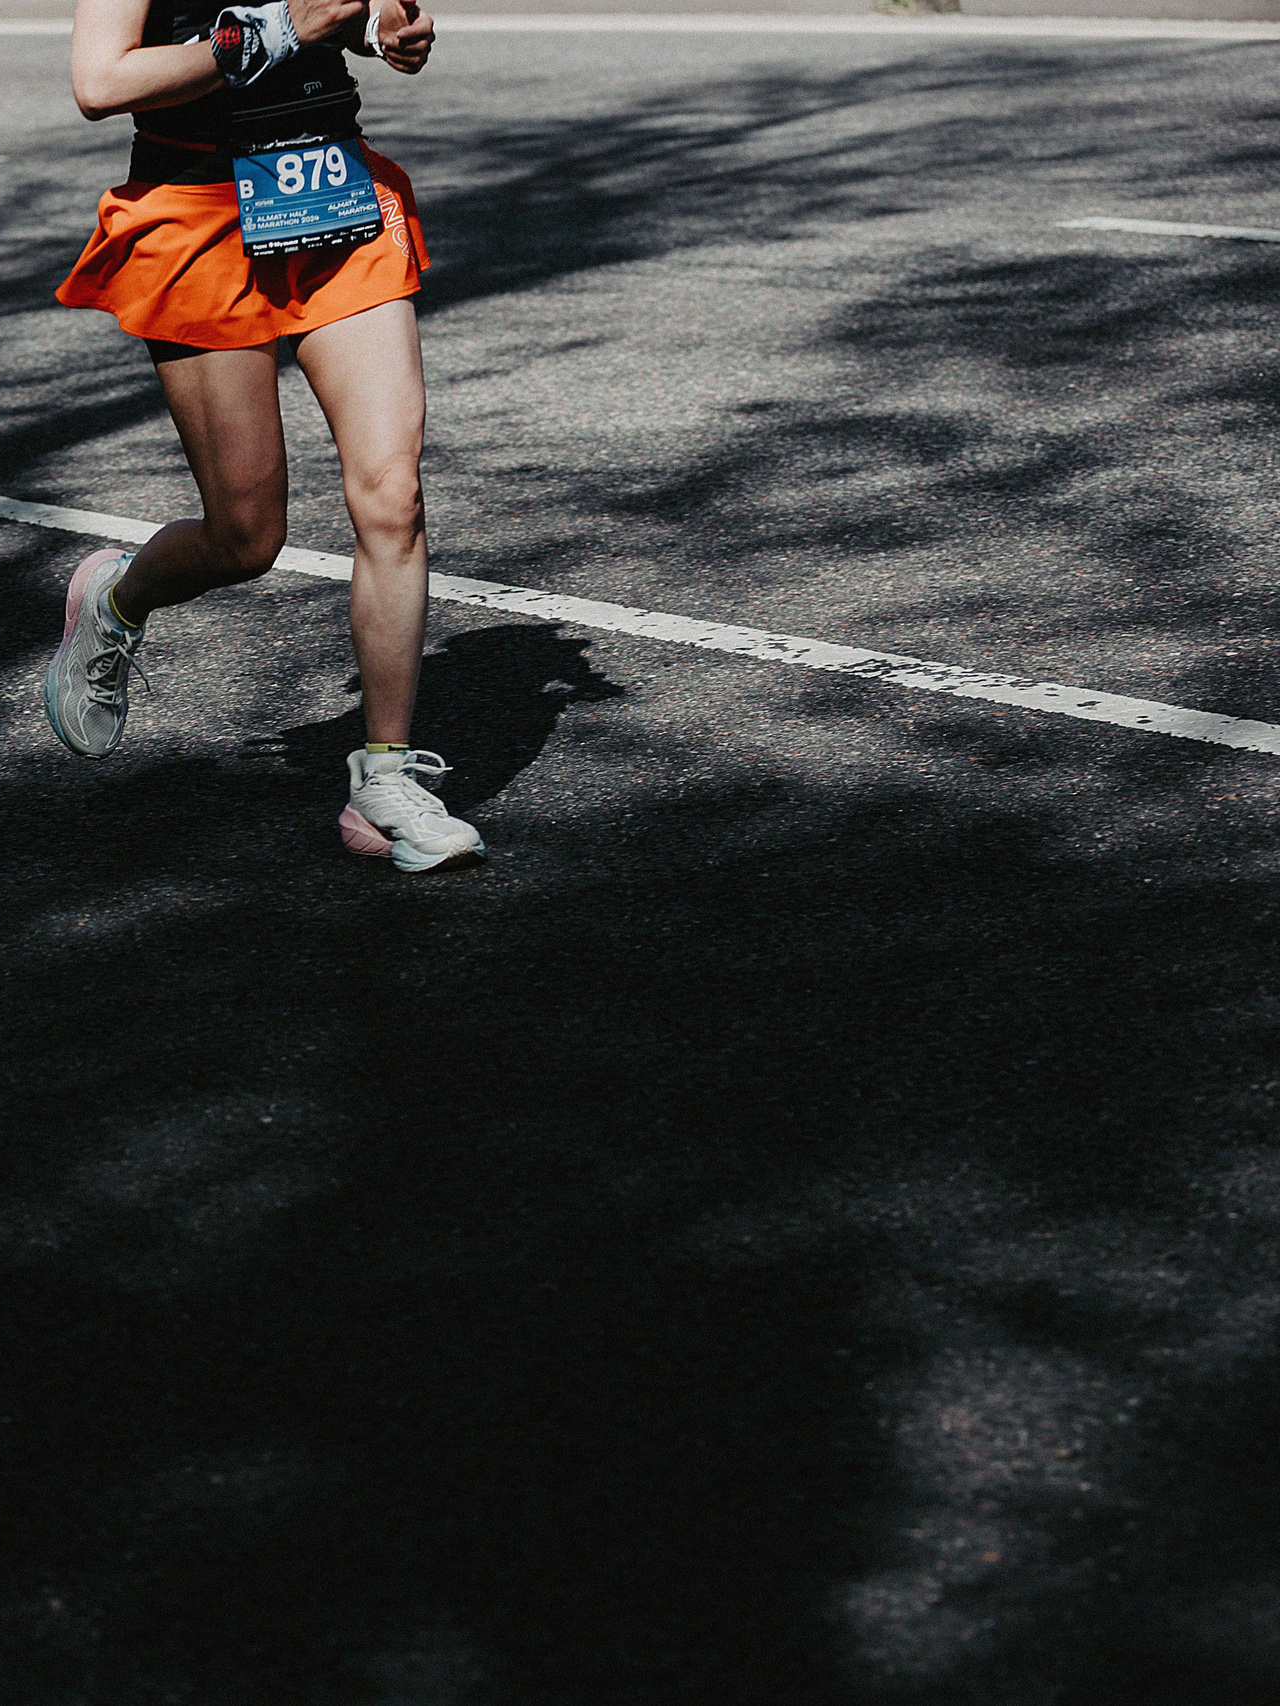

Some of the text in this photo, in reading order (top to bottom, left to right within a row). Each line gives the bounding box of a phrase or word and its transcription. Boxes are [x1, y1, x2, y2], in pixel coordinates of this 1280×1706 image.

[276, 145, 347, 195] 879
[239, 179, 254, 199] B
[328, 198, 358, 211] ALMATY
[338, 203, 378, 218] MARATHON
[257, 209, 308, 223] ALMATY HALF
[257, 217, 300, 230] MARATHON
